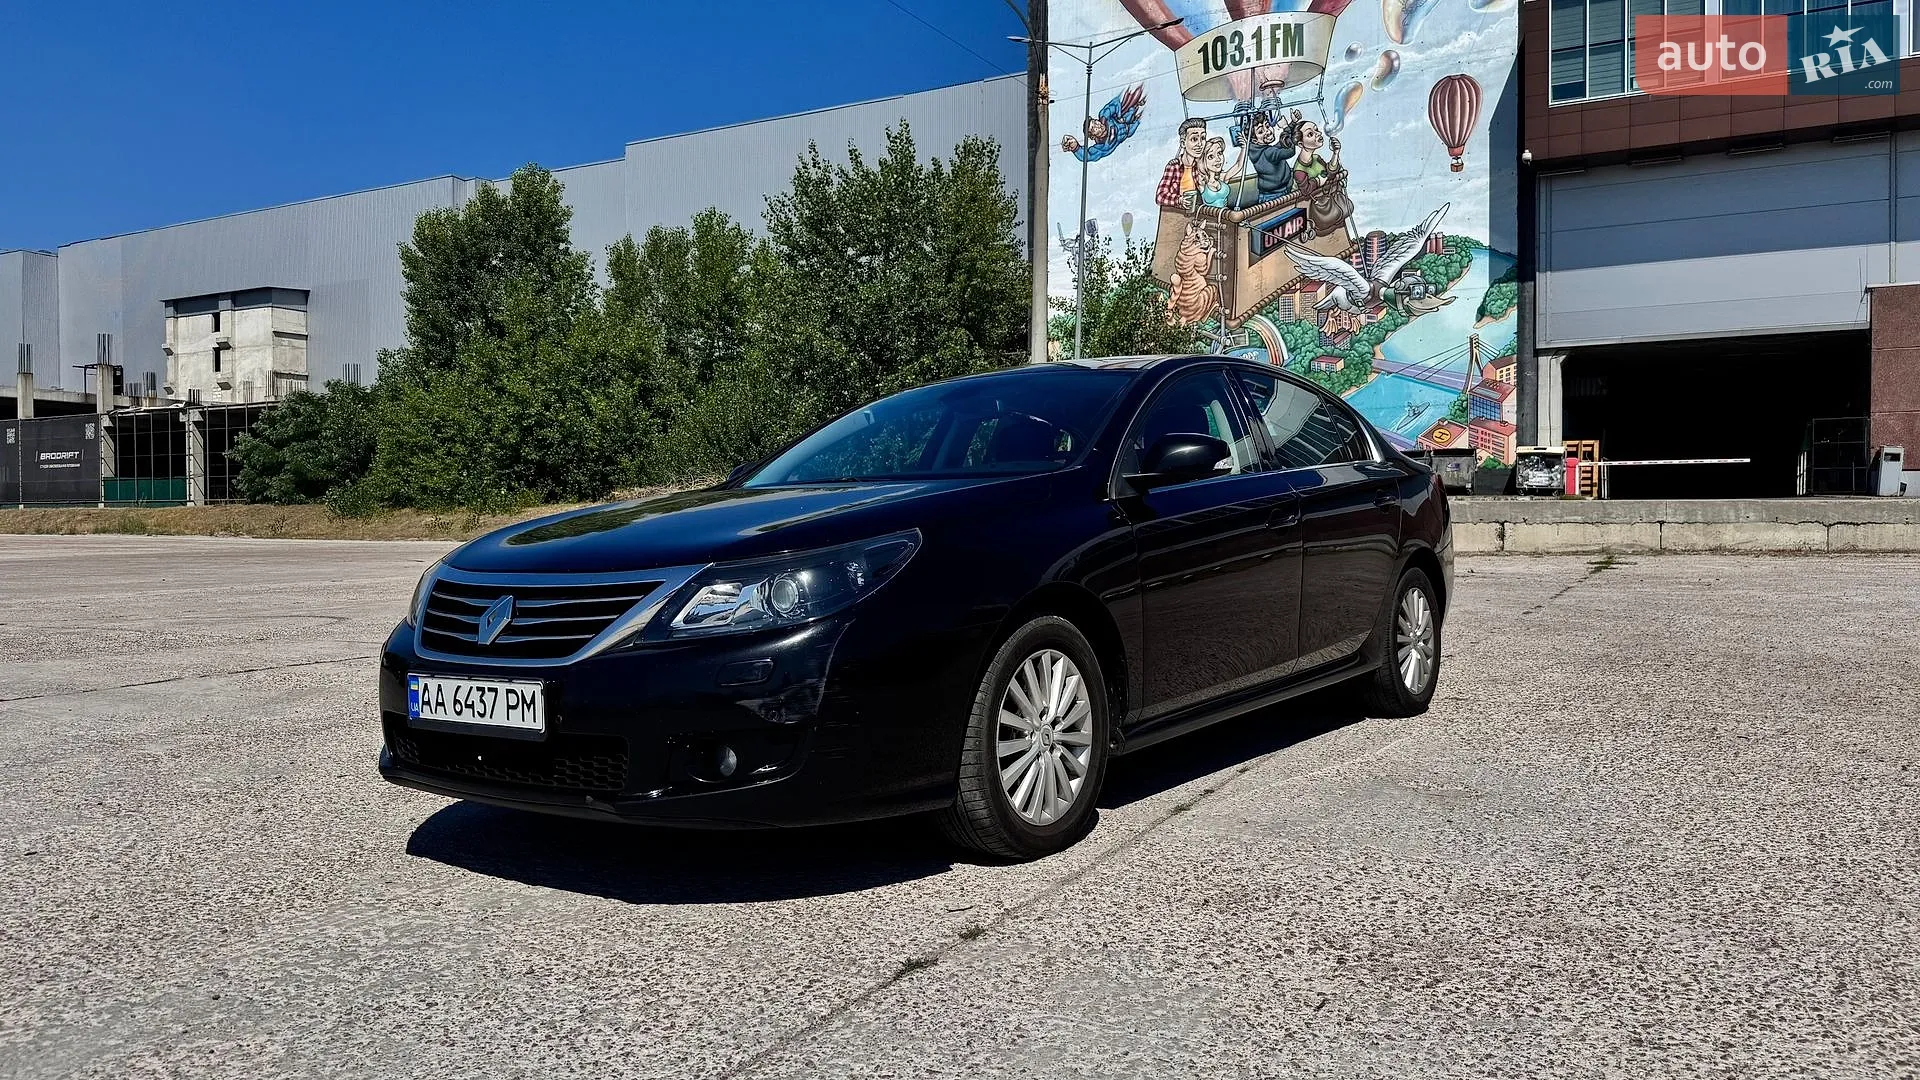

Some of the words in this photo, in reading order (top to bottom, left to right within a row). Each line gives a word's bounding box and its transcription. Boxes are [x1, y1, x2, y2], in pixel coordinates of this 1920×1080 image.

[1197, 25, 1263, 74] 103.1
[1269, 22, 1304, 58] FM
[1264, 225, 1283, 248] ON
[1284, 216, 1304, 238] AIR
[40, 451, 80, 460] BRODRIFT
[421, 682, 448, 715] AA
[453, 685, 499, 719] 6437
[505, 688, 537, 723] PM
